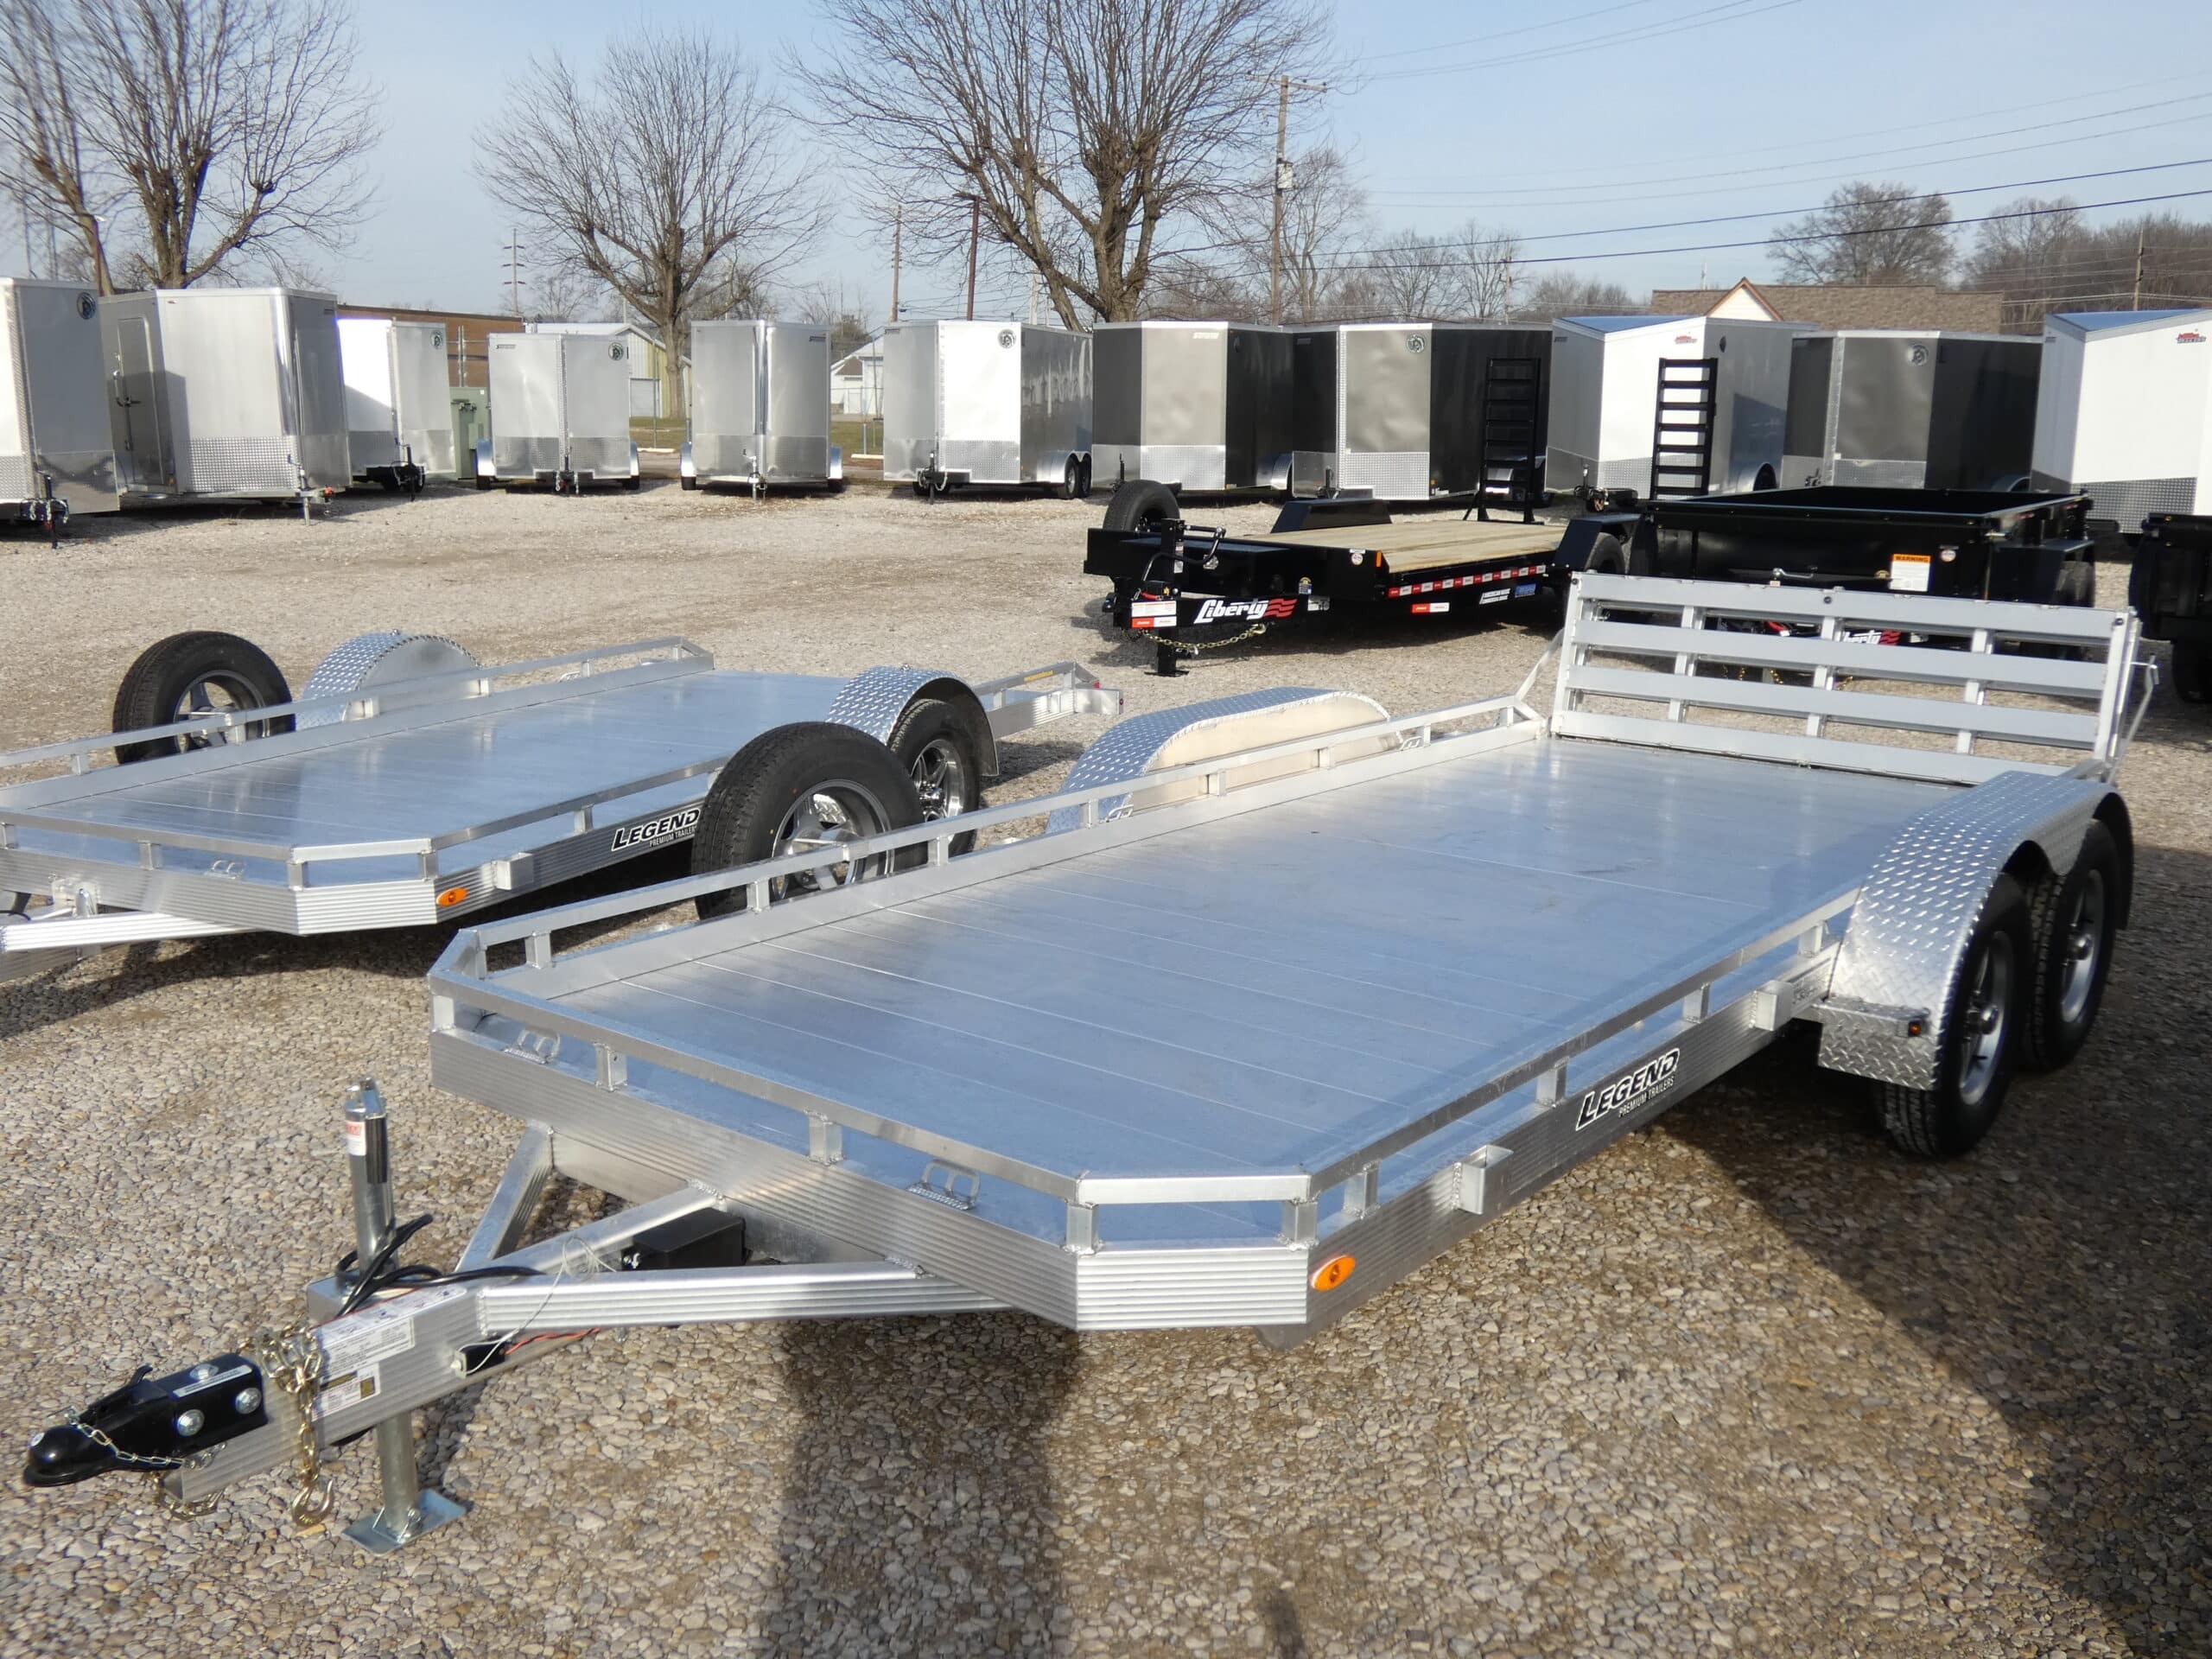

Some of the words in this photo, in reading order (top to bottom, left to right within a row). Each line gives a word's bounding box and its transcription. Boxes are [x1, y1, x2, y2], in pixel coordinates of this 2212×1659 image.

[1194, 598, 1269, 624] Liberty
[611, 808, 701, 851] LEGEND
[649, 834, 674, 848] PREMIUM
[1575, 1047, 1681, 1132] LEGEND
[1618, 1091, 1647, 1118] PREMIUM
[1648, 1077, 1675, 1100] TRAILERS
